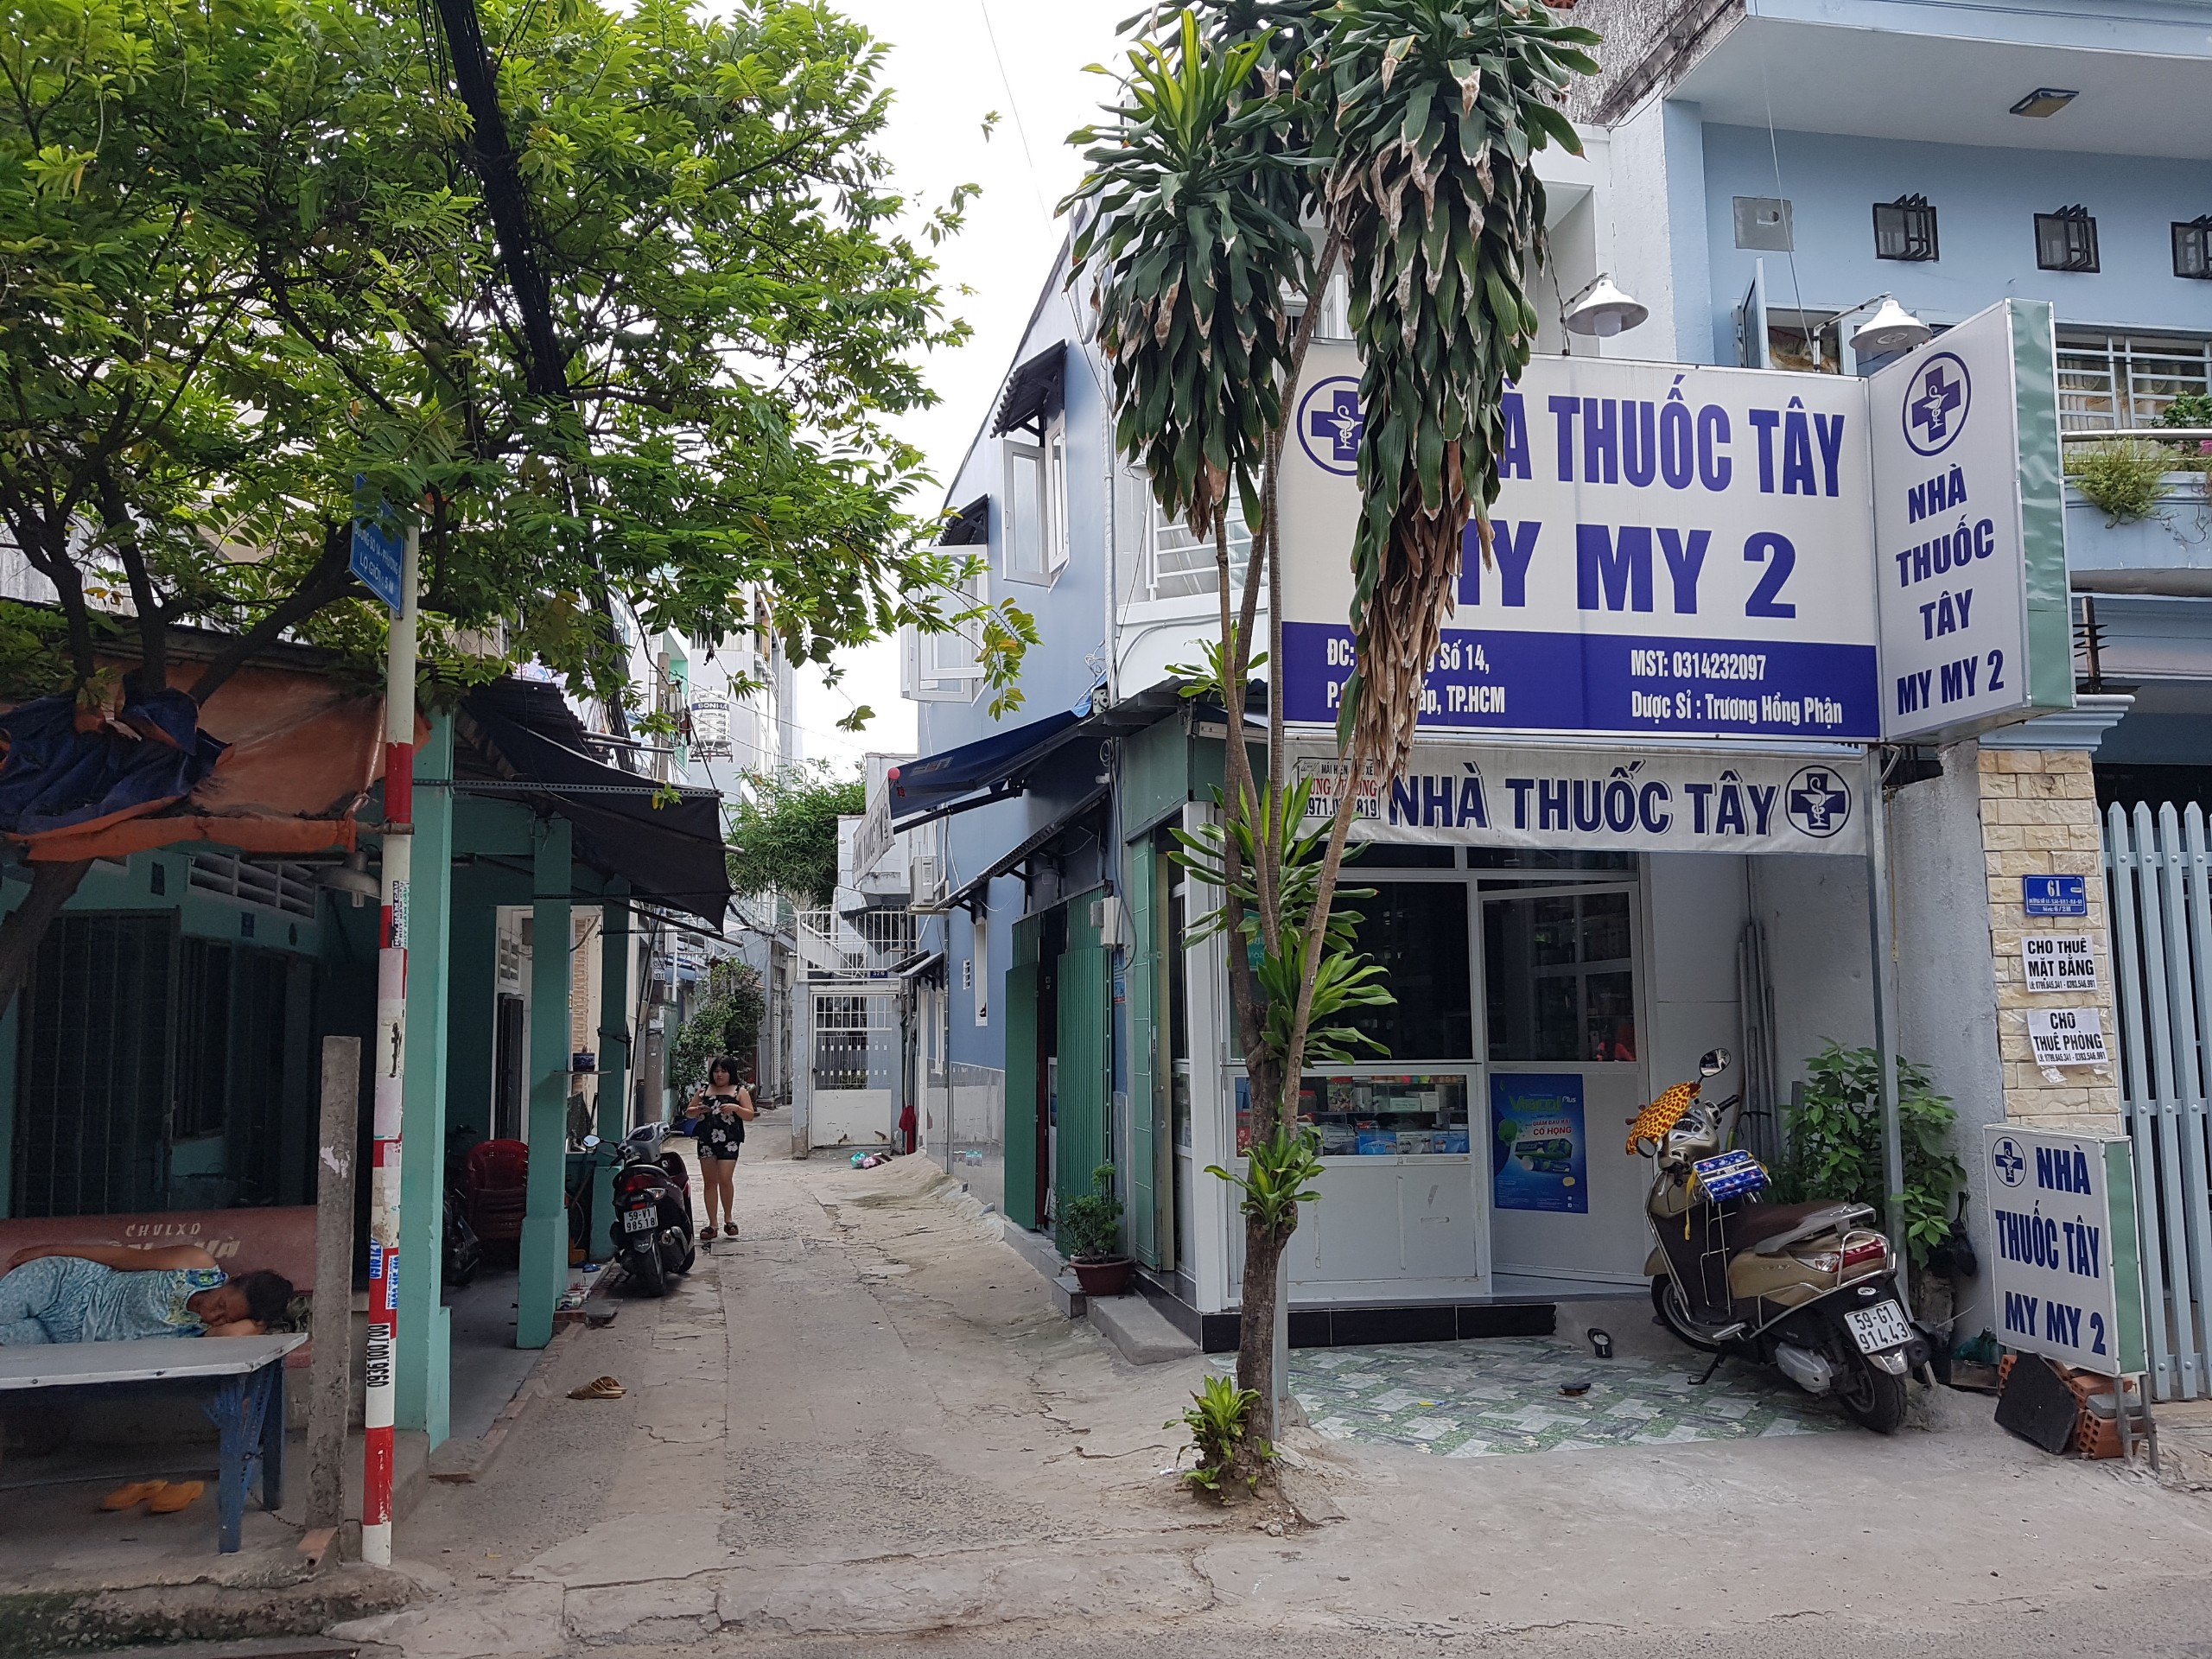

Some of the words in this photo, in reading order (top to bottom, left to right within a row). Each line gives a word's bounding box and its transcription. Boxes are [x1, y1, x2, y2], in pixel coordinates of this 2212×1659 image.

[1548, 375, 1732, 493] THUỐC
[1749, 396, 1846, 498] TÂY
[1908, 463, 1967, 524] NHÀ
[1896, 514, 1994, 588] THUỐC
[1457, 519, 1542, 607] Y
[1576, 524, 1712, 615] MY
[1743, 531, 1797, 620] 2
[1919, 588, 1973, 640] TÂY
[1327, 639, 1354, 666] ĐC:
[1440, 639, 1462, 671] Số
[1465, 645, 1490, 674] 14,
[1631, 650, 1669, 677] MST:
[1673, 652, 1766, 680] 0314232097
[1419, 679, 1441, 715] ấp,
[1446, 685, 1505, 714] TP.HCM
[1897, 668, 1931, 715] MY
[1940, 655, 1978, 704] MY
[1987, 649, 2004, 691] 2
[1631, 690, 1671, 724] Dược
[1705, 694, 1758, 724] Trương
[1762, 692, 1800, 726] Hồng
[1804, 696, 1842, 729] Phận
[1321, 762, 1332, 775] MÁI
[1389, 761, 1491, 830] NHÀ
[1506, 760, 1673, 836] THUỐC
[1684, 770, 1782, 838] TÂY
[2047, 880, 2061, 897] 61
[2027, 940, 2053, 954] CHO
[2057, 938, 2087, 954] THUÊ
[2028, 957, 2054, 981] MẶT
[2058, 954, 2094, 976] BẰNG
[2050, 1012, 2075, 1029] CHO
[2033, 1032, 2061, 1051] THUÊ
[2063, 1030, 2103, 1050] PHÒNG
[1548, 1127, 1572, 1135] HỌNG
[2036, 1144, 2092, 1195] NHÀ
[626, 1217, 656, 1231] 985.18
[629, 1208, 652, 1221] 59-V1
[1995, 1199, 2059, 1270] THUỐC
[2063, 1215, 2100, 1279] TÂY
[1854, 1306, 1894, 1331] 59-G1
[1859, 1322, 1909, 1350] 914.43
[2005, 1291, 2038, 1337] MY
[2046, 1300, 2082, 1349] MY
[2090, 1312, 2107, 1356] 2
[366, 1325, 389, 1387] 0936.100.700
